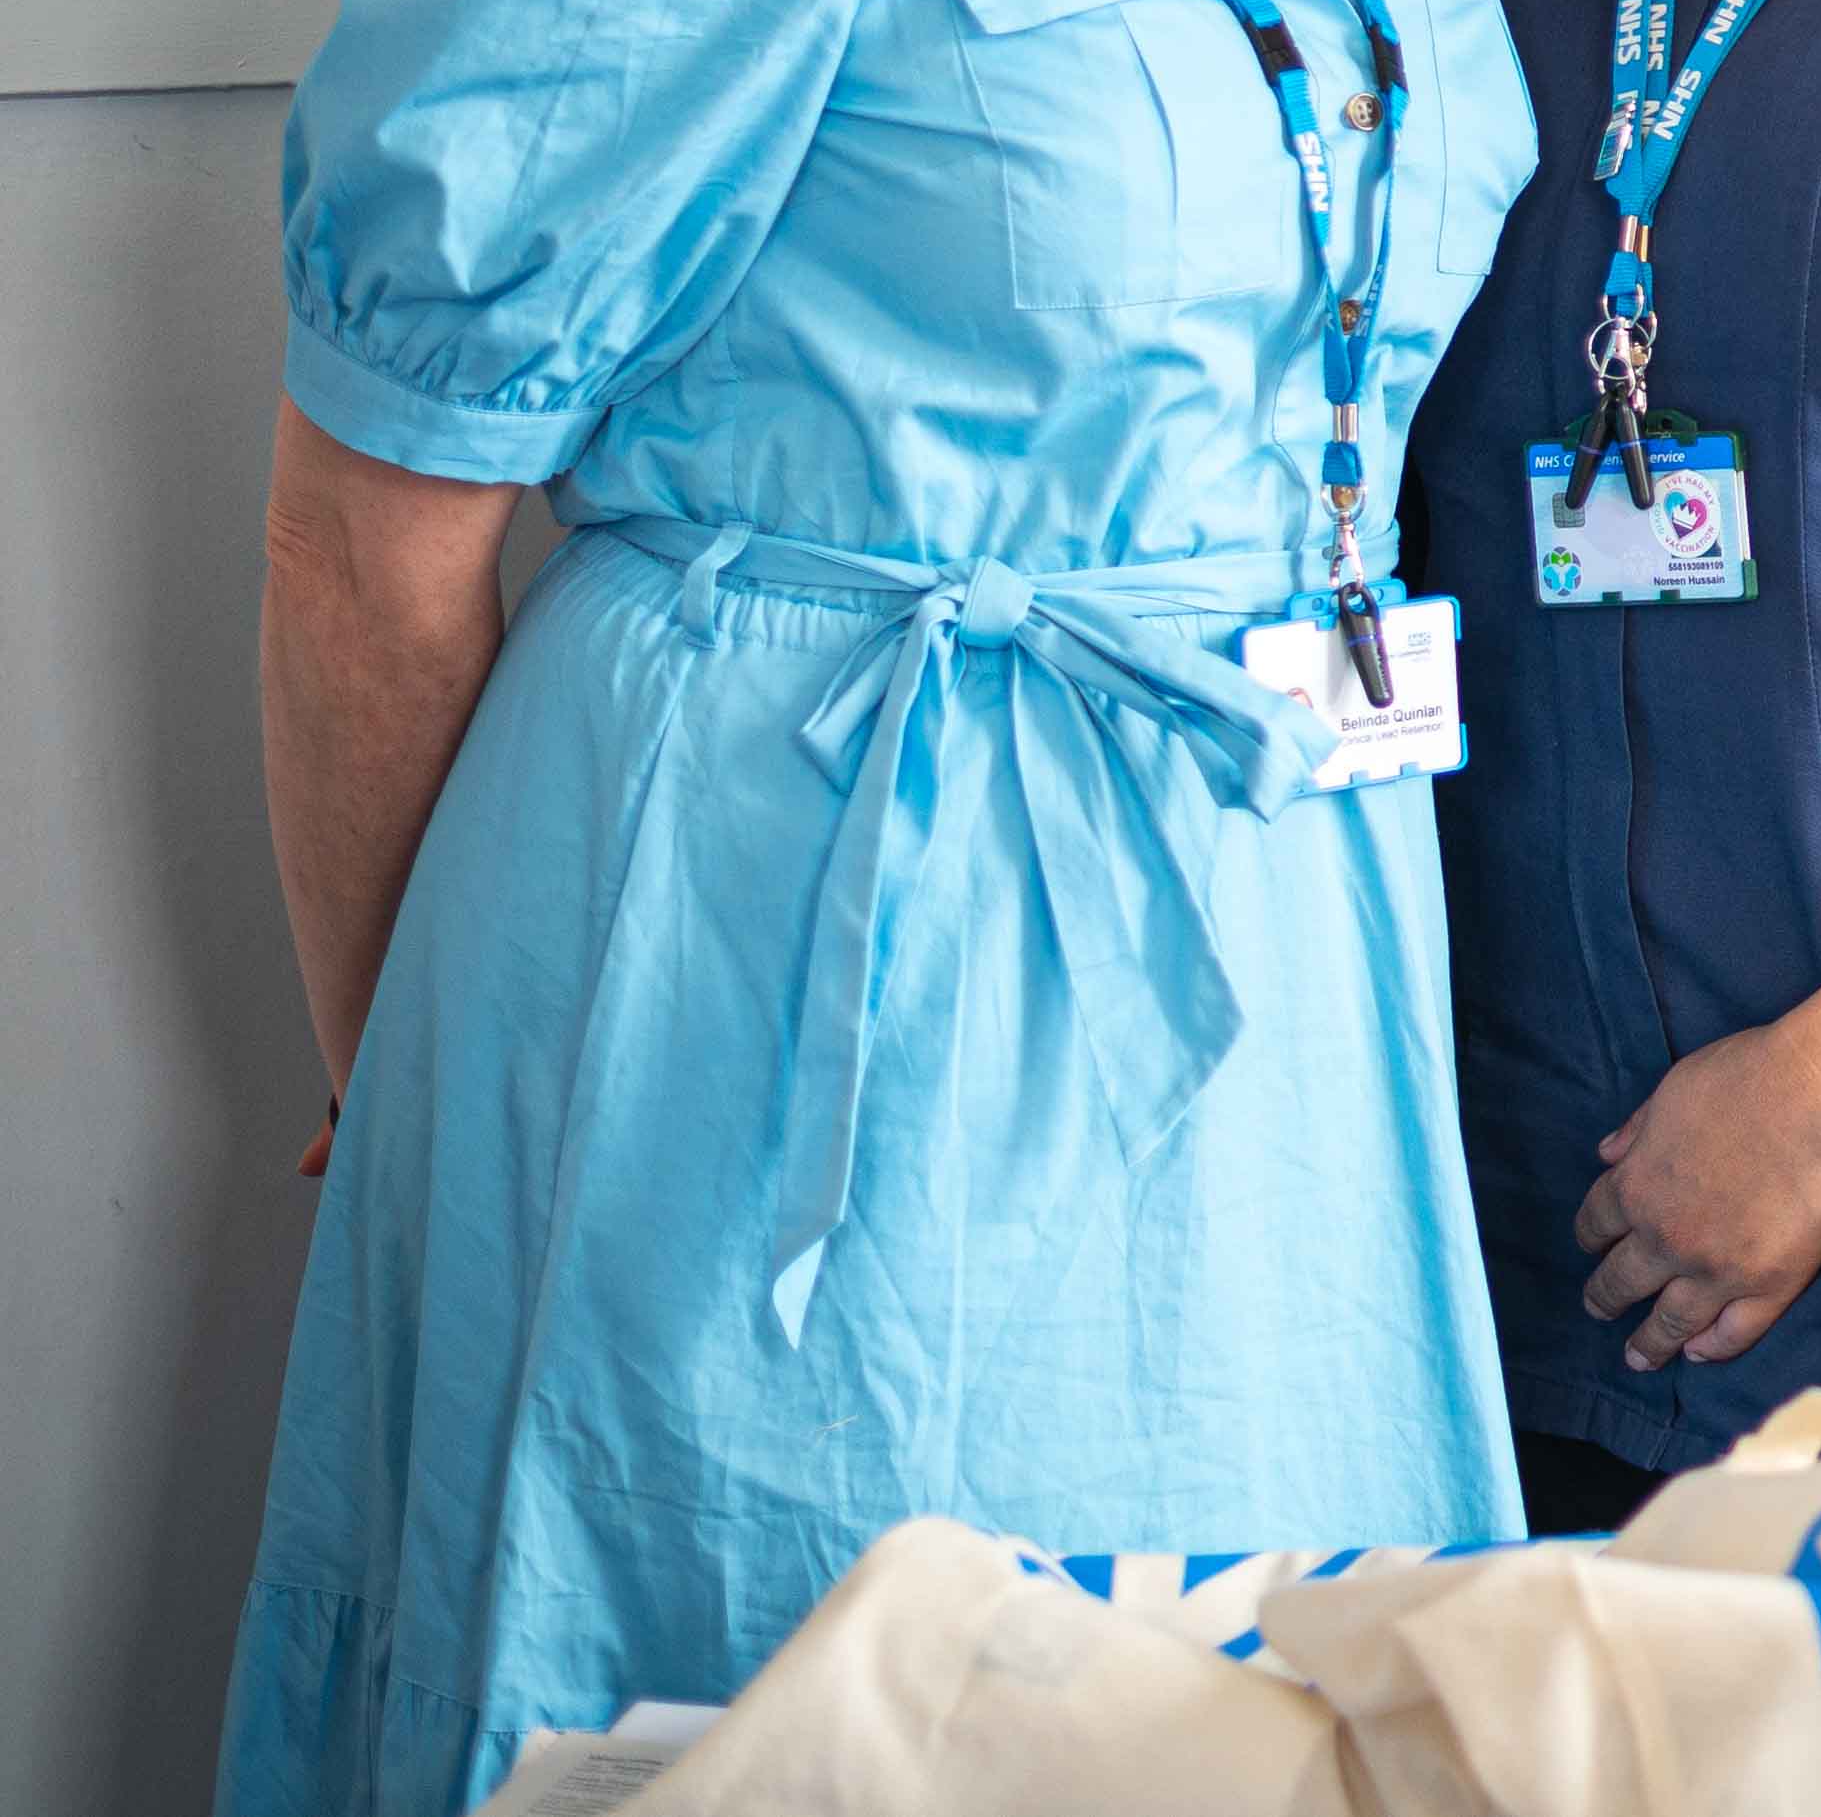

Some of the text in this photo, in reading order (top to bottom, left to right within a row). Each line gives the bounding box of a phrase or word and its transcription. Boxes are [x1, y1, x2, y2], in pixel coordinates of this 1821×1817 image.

[1647, 3, 1668, 72] NHS
[1653, 68, 1702, 141] NHS
[1295, 132, 1330, 212] NHS
[1535, 455, 1560, 469] NHS
[1650, 450, 1686, 464] ervice
[1653, 574, 1726, 586] Noreen Hussain
[1341, 705, 1443, 732] Belinda Quinlan
